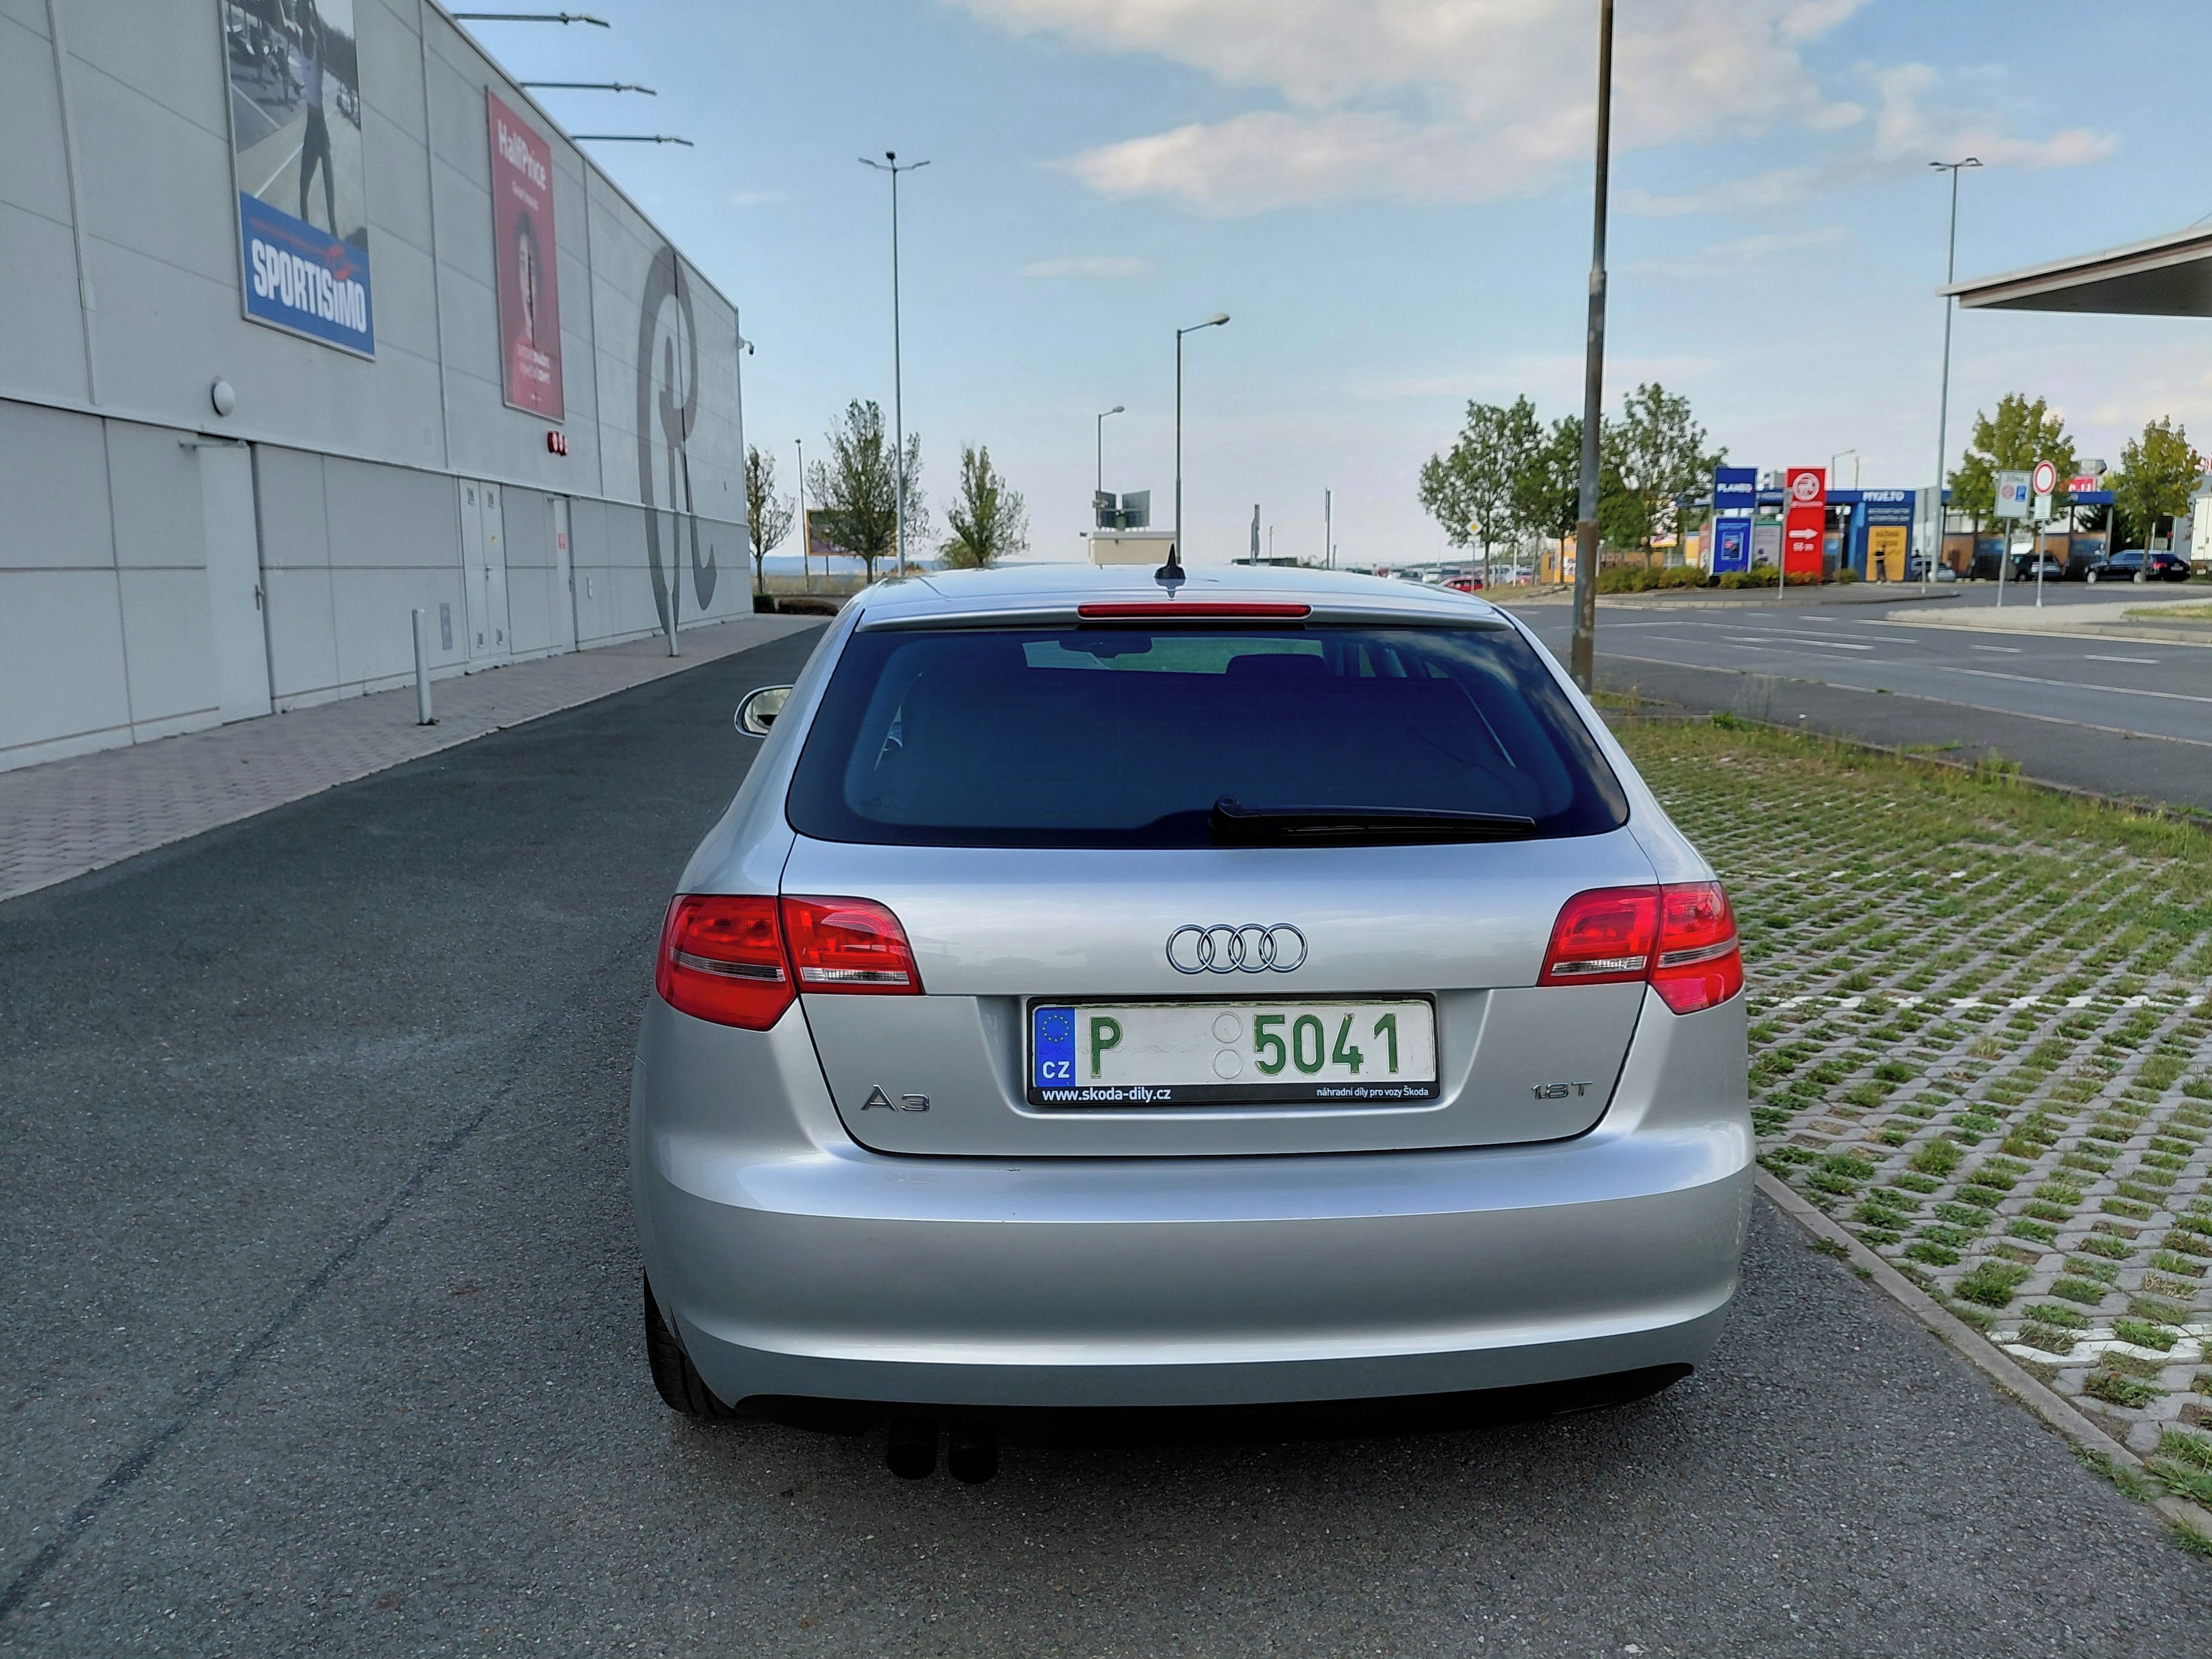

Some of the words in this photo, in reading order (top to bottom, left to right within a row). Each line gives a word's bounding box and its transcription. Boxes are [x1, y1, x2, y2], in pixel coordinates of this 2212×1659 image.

[497, 118, 546, 191] HalfPrice
[252, 238, 367, 333] SPORTISIMO
[1090, 1015, 1122, 1078] P
[1253, 1013, 1399, 1075] 5041
[1043, 1061, 1070, 1078] CZ
[860, 1083, 930, 1113] A3
[1042, 1086, 1172, 1103] www.skoda-dily.cz
[1316, 1086, 1353, 1096] náhradní
[1354, 1087, 1368, 1097] díly
[1384, 1090, 1403, 1098] vozy
[1403, 1085, 1429, 1096] Škoda
